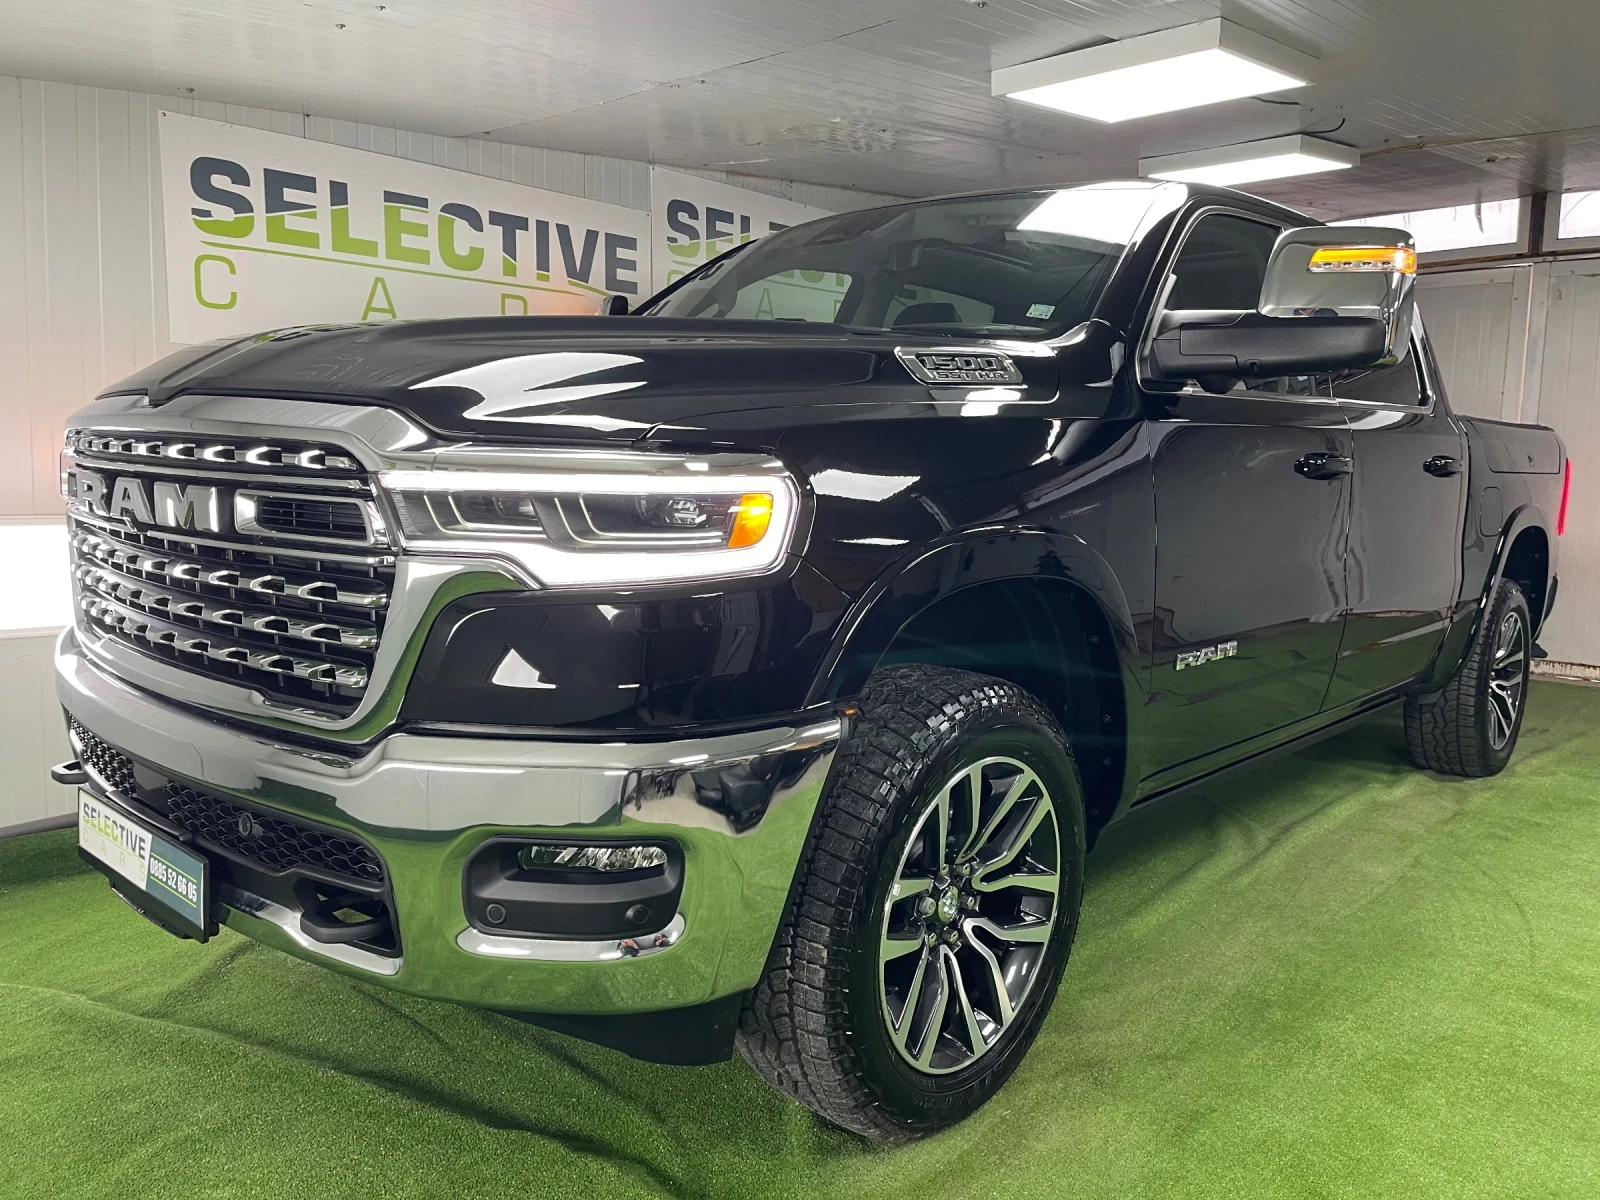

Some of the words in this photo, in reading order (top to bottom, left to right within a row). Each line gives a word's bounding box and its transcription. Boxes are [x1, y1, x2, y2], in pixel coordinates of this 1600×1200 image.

[189, 156, 638, 295] SELECTIVE
[918, 355, 1003, 370] 1500
[70, 470, 221, 533] RAM
[1175, 640, 1238, 671] RAM
[83, 802, 146, 861] SELECTIVE
[149, 857, 166, 882] 0885
[167, 868, 177, 889] 52
[177, 874, 187, 896] 66
[187, 881, 197, 903] 05
